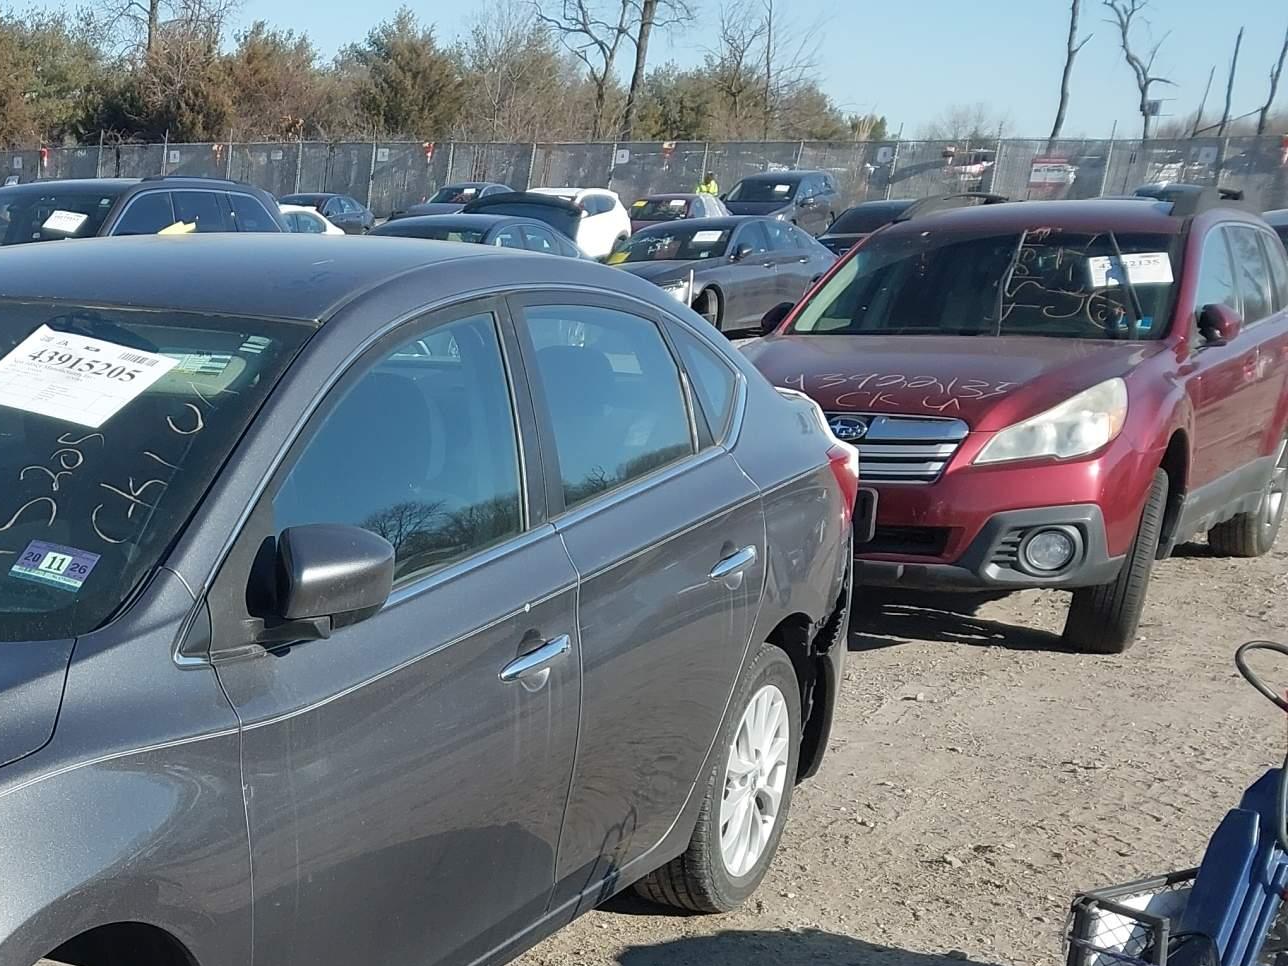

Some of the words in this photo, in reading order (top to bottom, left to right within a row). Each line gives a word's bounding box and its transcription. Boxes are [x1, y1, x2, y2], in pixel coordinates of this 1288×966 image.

[28, 348, 144, 382] 43915205
[23, 551, 42, 563] 20
[45, 555, 66, 572] 11
[69, 562, 88, 574] 26
